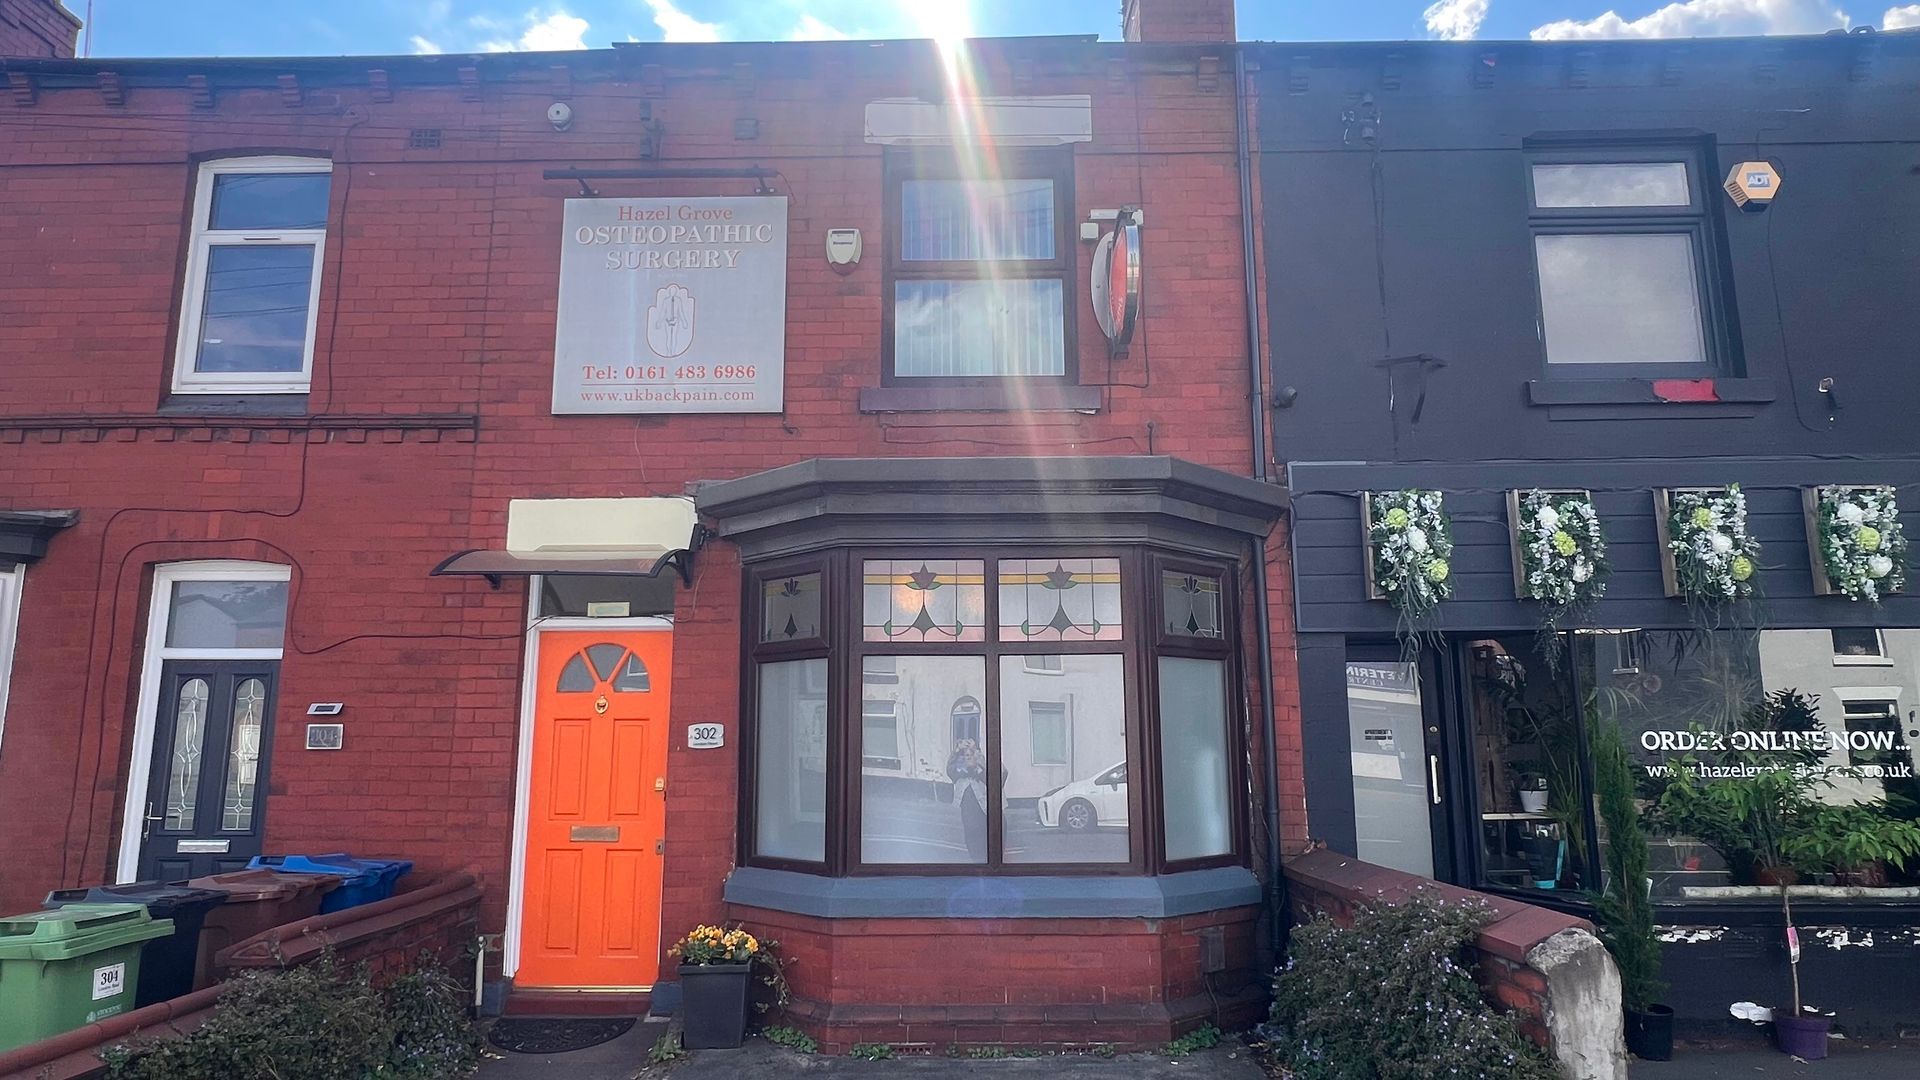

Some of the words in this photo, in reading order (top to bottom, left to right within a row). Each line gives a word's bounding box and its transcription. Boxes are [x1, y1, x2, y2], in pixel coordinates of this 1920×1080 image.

[1748, 173, 1769, 185] ADT
[617, 205, 671, 221] Hazel
[678, 204, 733, 221] Grove
[575, 224, 774, 245] OSTEOPATHIC
[606, 249, 741, 270] SURGERY
[582, 365, 618, 379] Tel:
[625, 365, 666, 379] 0161
[675, 365, 706, 379] 483
[713, 365, 756, 379] 6986
[580, 387, 755, 403] www.ukbackpain.com
[693, 727, 717, 740] 302
[1641, 731, 1727, 750] ORDER
[1730, 731, 1827, 750] ONLINE
[1829, 731, 1911, 750] NOW...
[100, 970, 119, 985] 304
